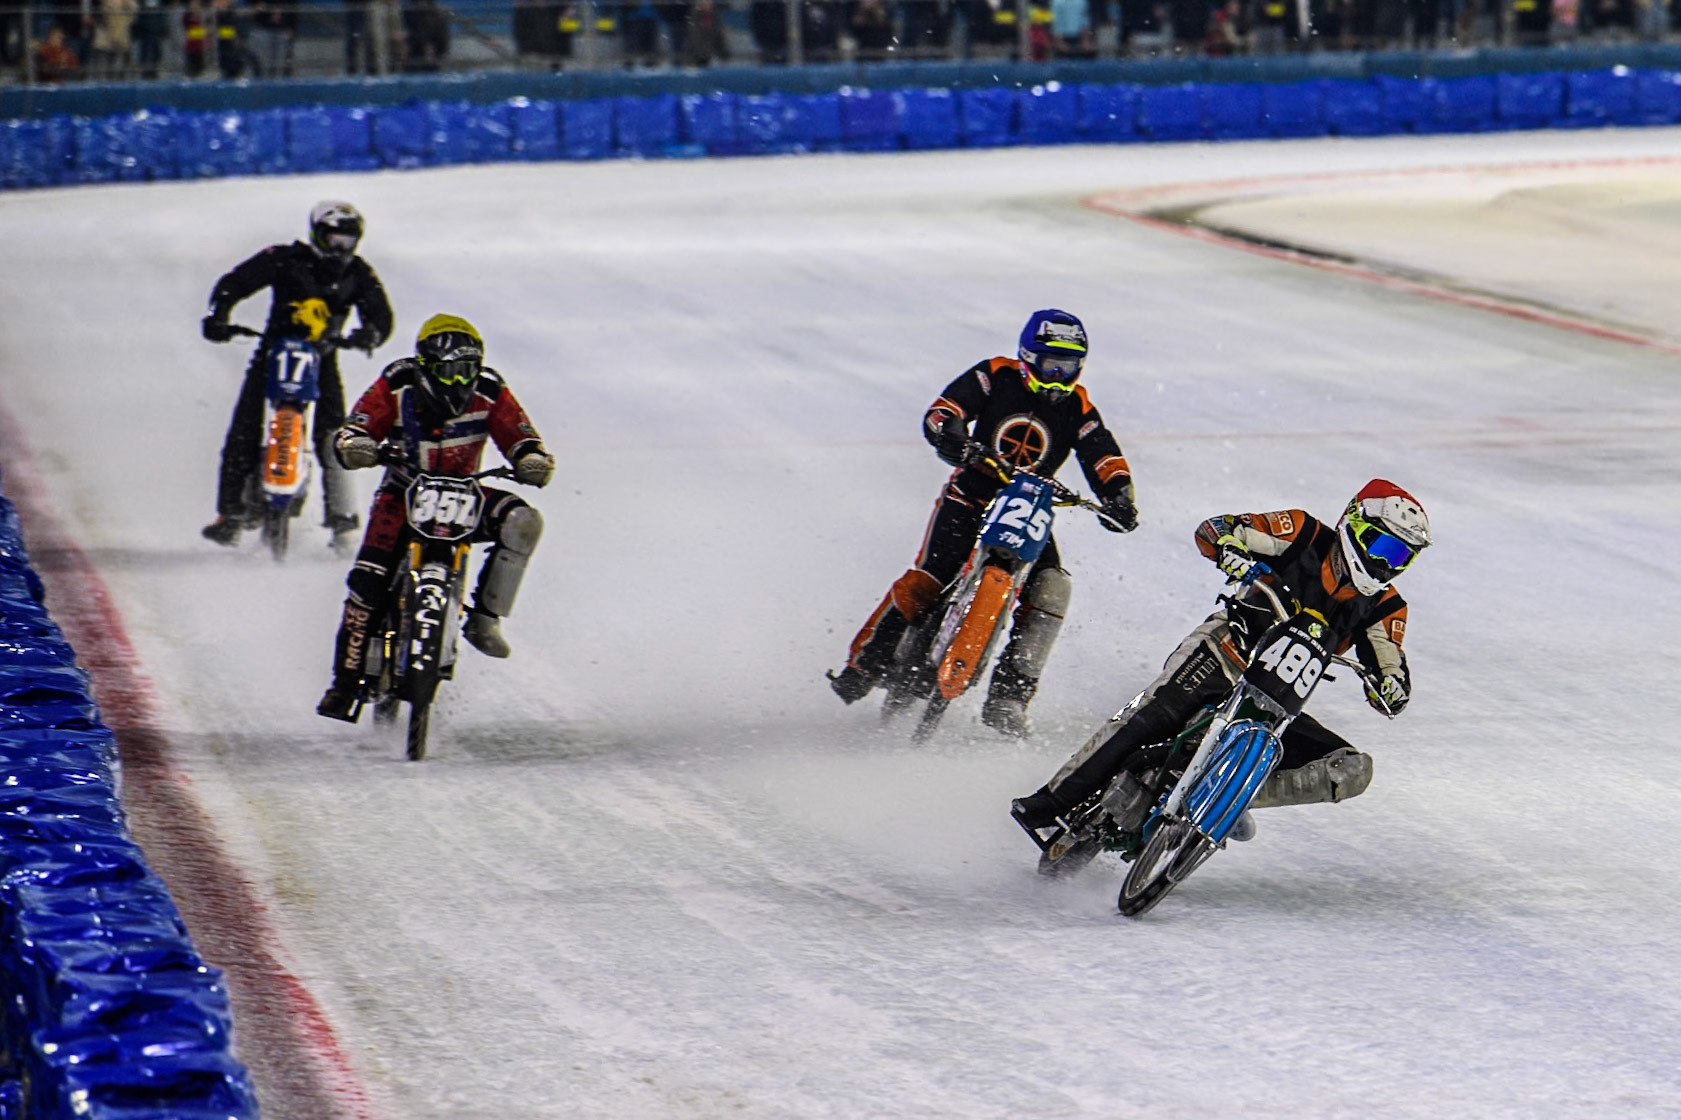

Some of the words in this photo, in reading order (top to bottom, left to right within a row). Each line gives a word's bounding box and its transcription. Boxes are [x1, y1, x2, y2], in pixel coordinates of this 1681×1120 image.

[276, 350, 313, 382] 17
[413, 489, 476, 525] 357
[986, 496, 1052, 542] 125
[1258, 635, 1323, 699] 489
